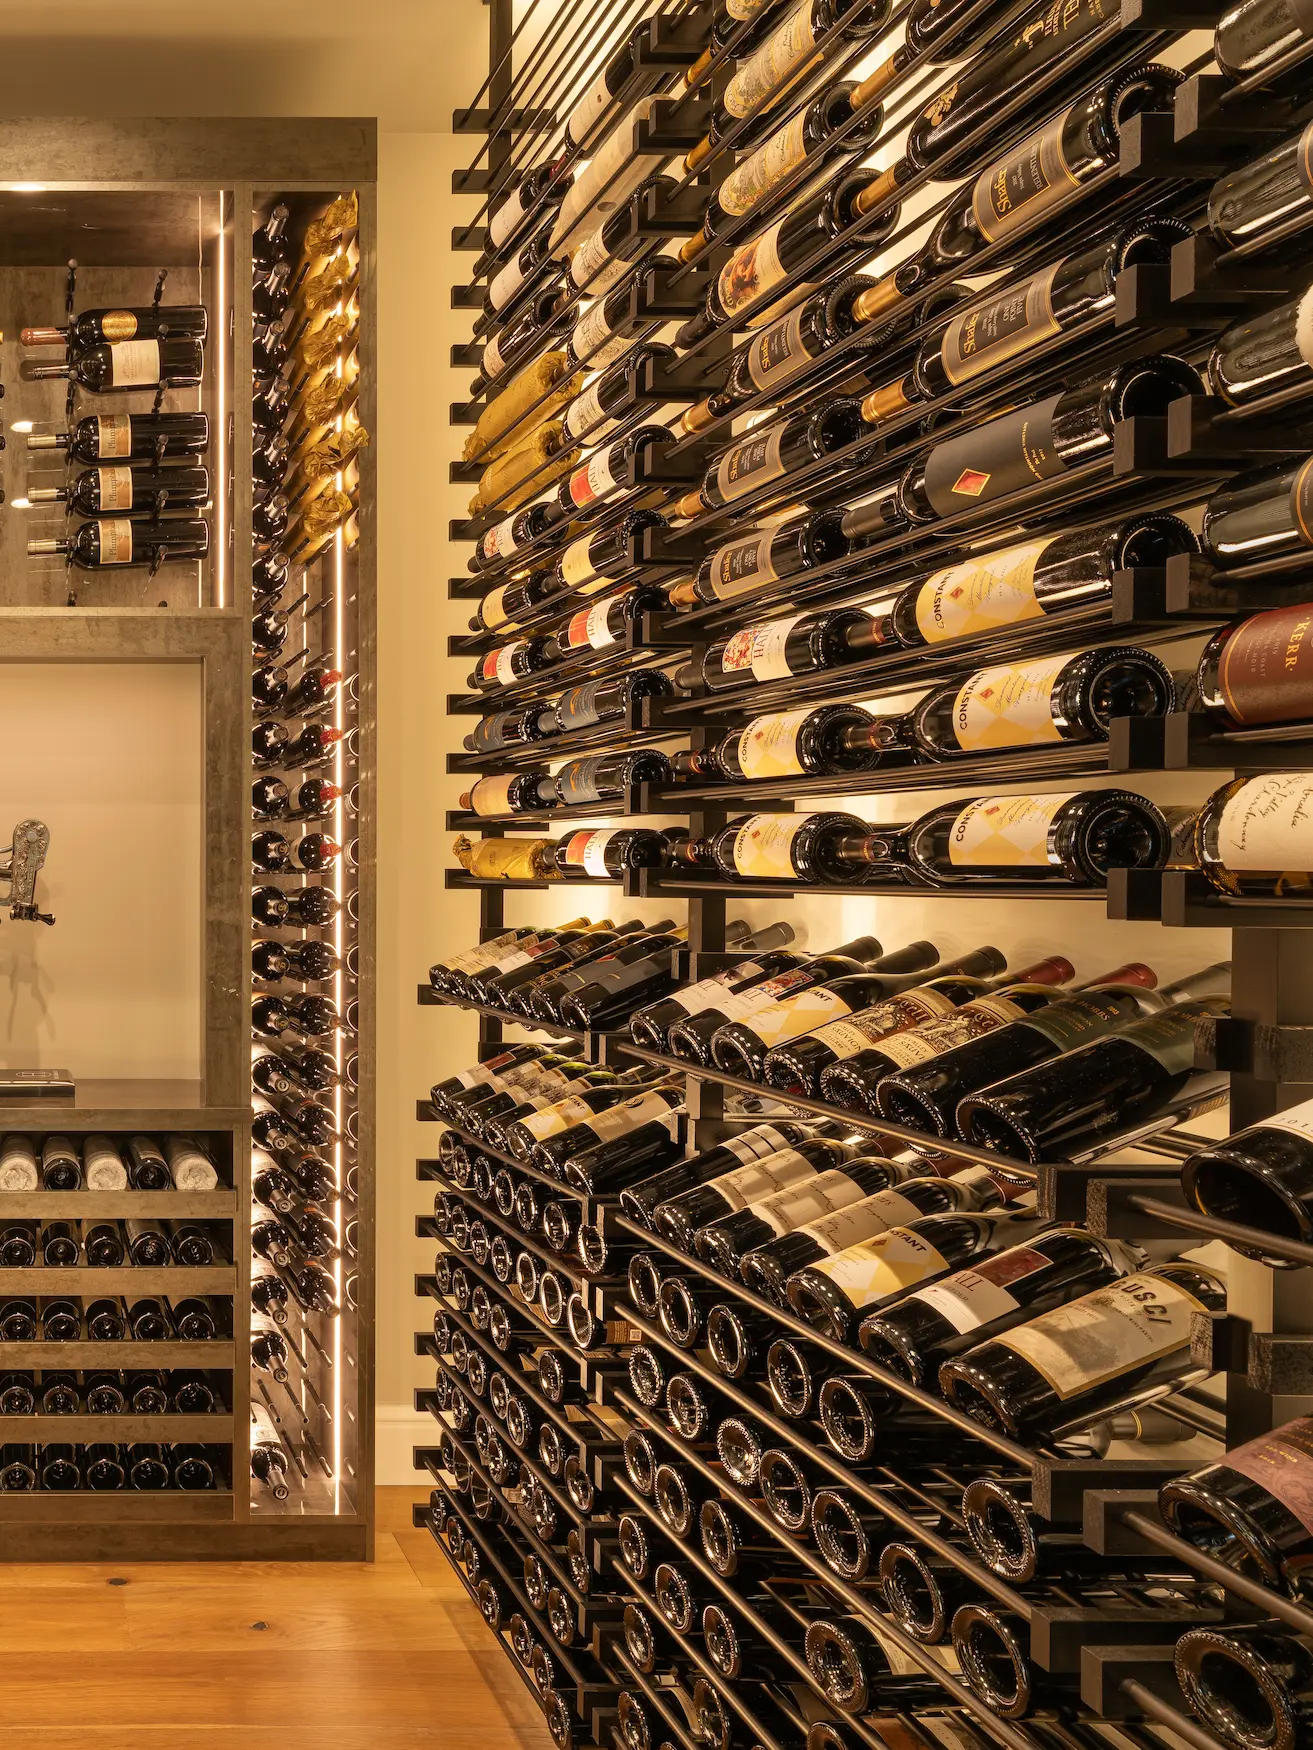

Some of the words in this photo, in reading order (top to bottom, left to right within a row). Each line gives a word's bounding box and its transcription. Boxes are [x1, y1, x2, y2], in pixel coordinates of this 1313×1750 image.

[996, 168, 1012, 213] Shafer
[1002, 304, 1011, 322] ONE
[1007, 297, 1018, 323] POINT
[1014, 295, 1025, 316] FIVE
[964, 312, 980, 354] Shafer
[761, 334, 771, 370] Shafer
[730, 449, 743, 480] Shafer
[723, 551, 733, 582] Shafer
[934, 572, 955, 630] CONSTANT
[958, 672, 989, 731] CONSTANT
[741, 716, 764, 763] CONSTANT
[737, 815, 762, 859] CONSTANT
[888, 1229, 927, 1253] NSTANT
